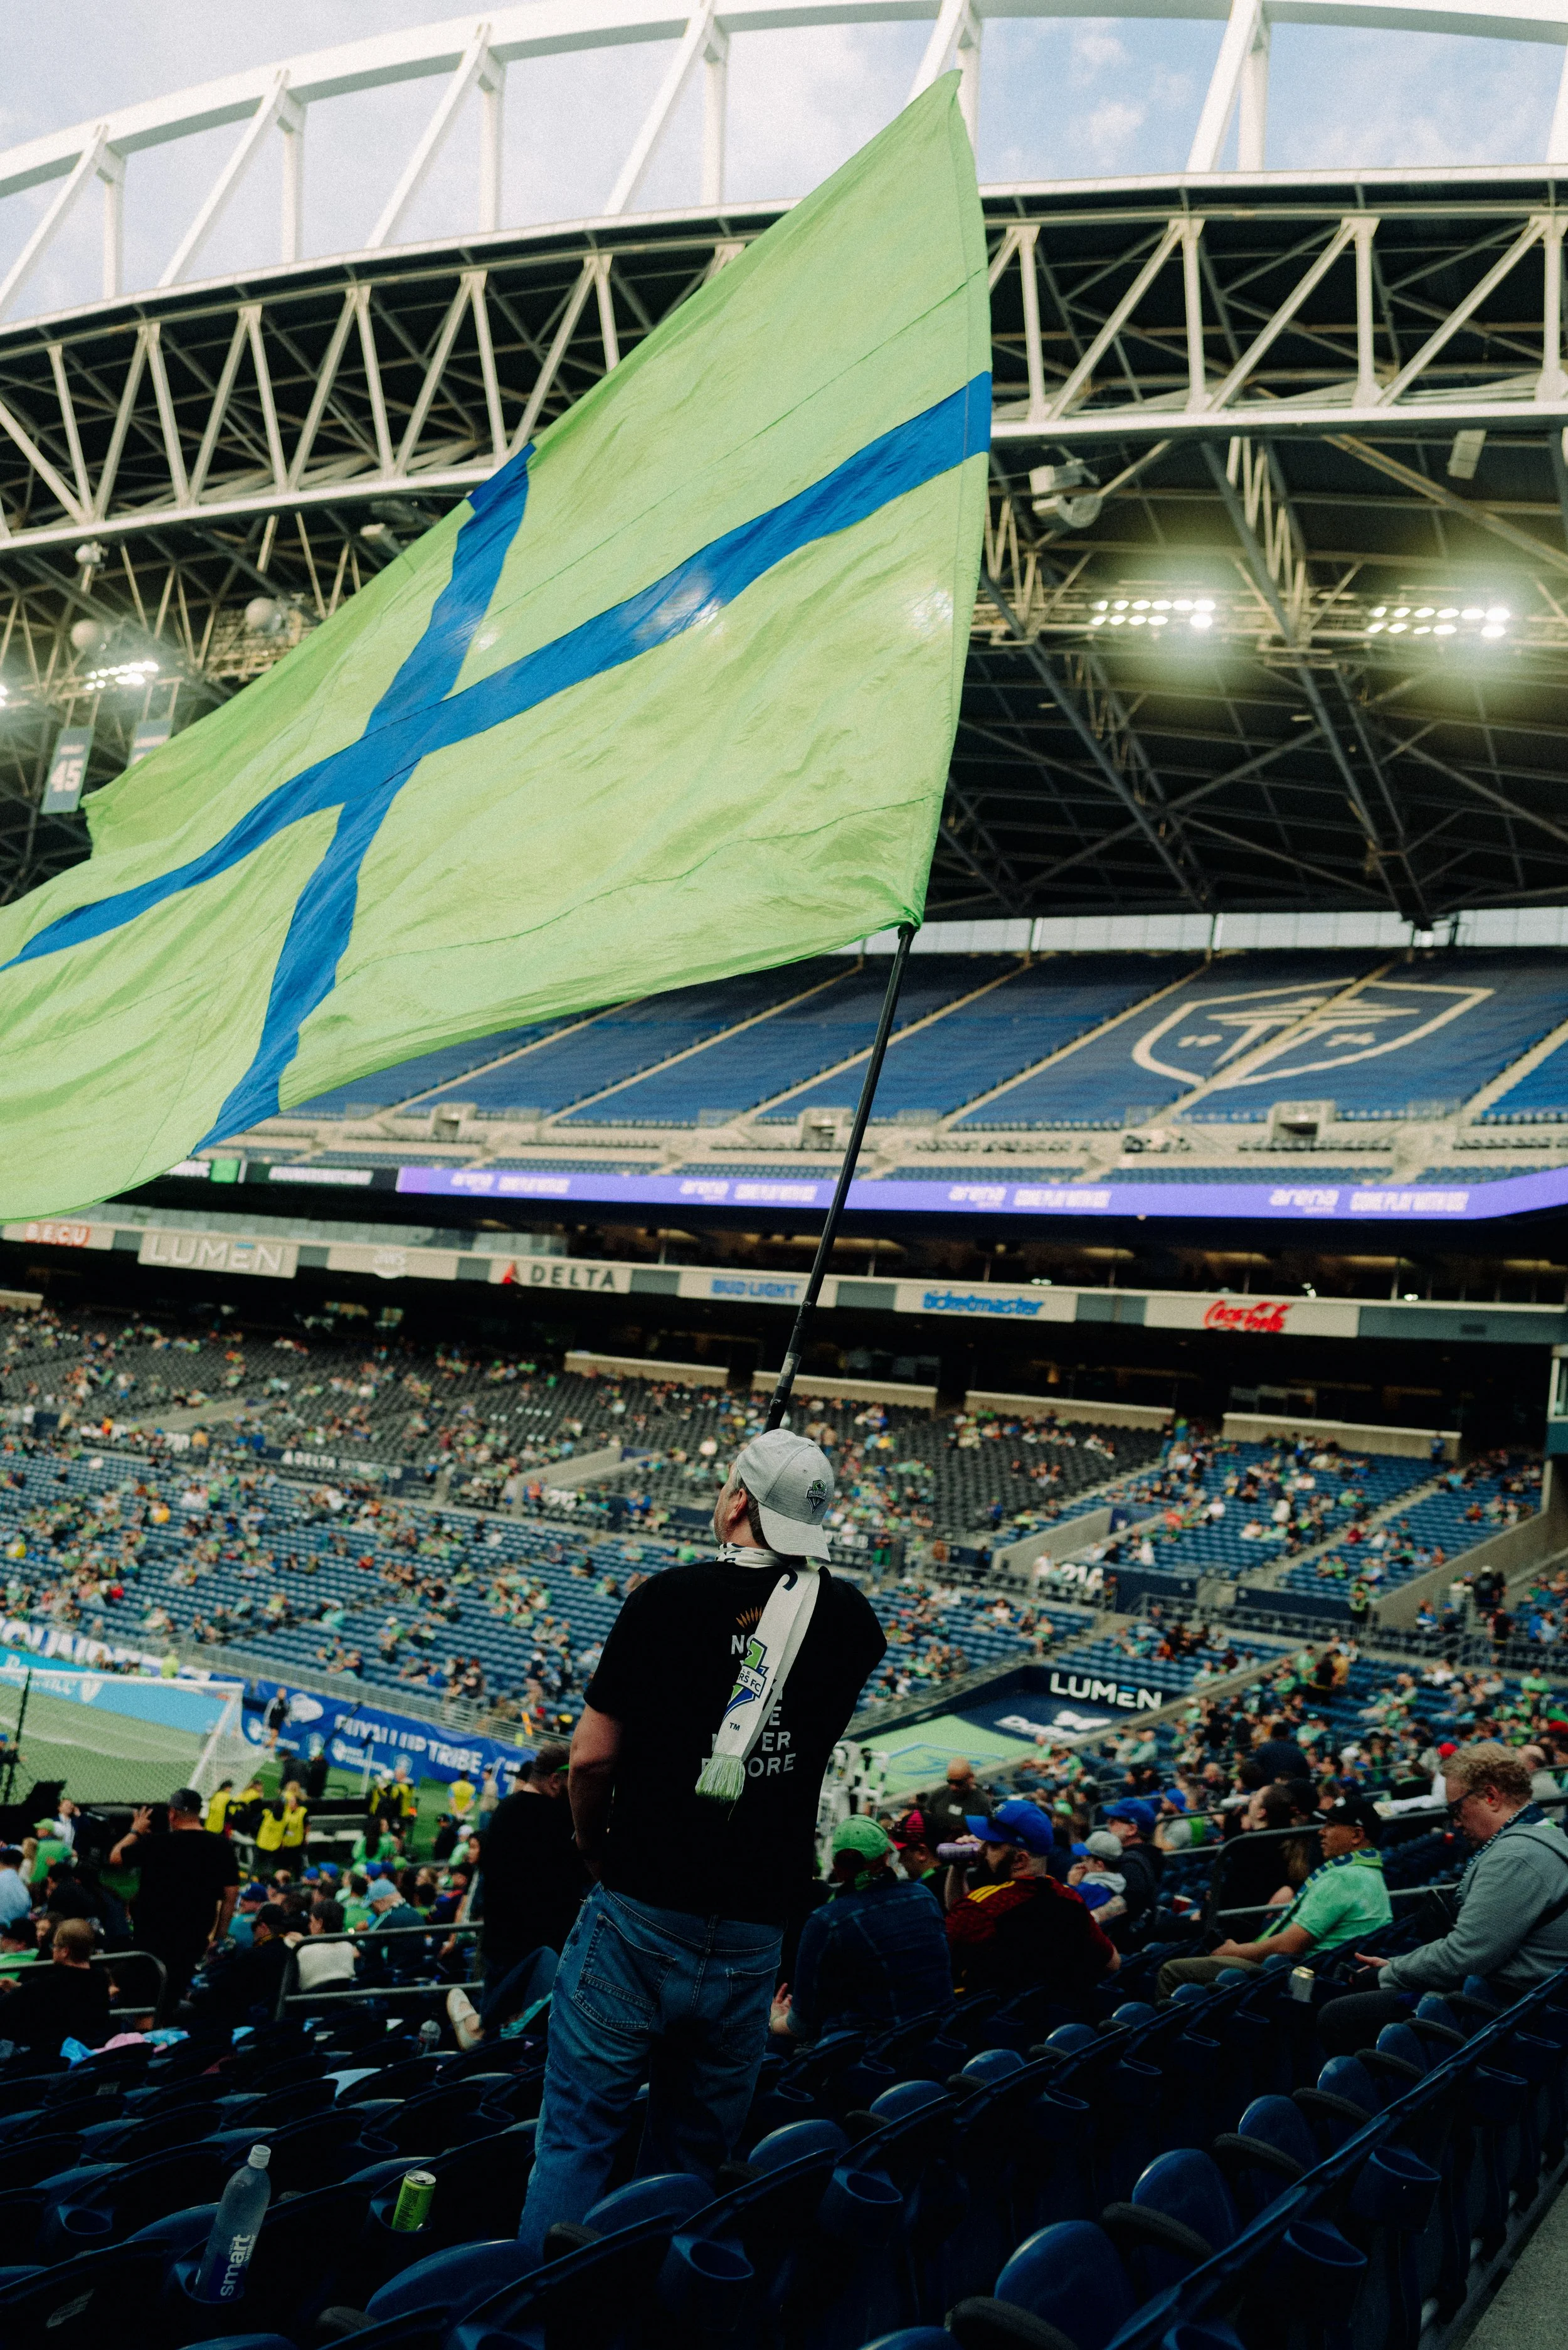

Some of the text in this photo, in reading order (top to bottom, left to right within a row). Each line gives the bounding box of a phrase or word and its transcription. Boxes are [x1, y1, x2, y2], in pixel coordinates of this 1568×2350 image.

[50, 758, 83, 792] 45
[531, 1263, 615, 1290] DELTA
[711, 1280, 797, 1299] BUD LIGHT
[750, 1679, 761, 1693] FC
[1050, 1672, 1162, 1710] LUMEN
[729, 1722, 741, 1731] TM
[428, 1739, 483, 1775] TRIBE
[220, 2234, 252, 2296] smart
